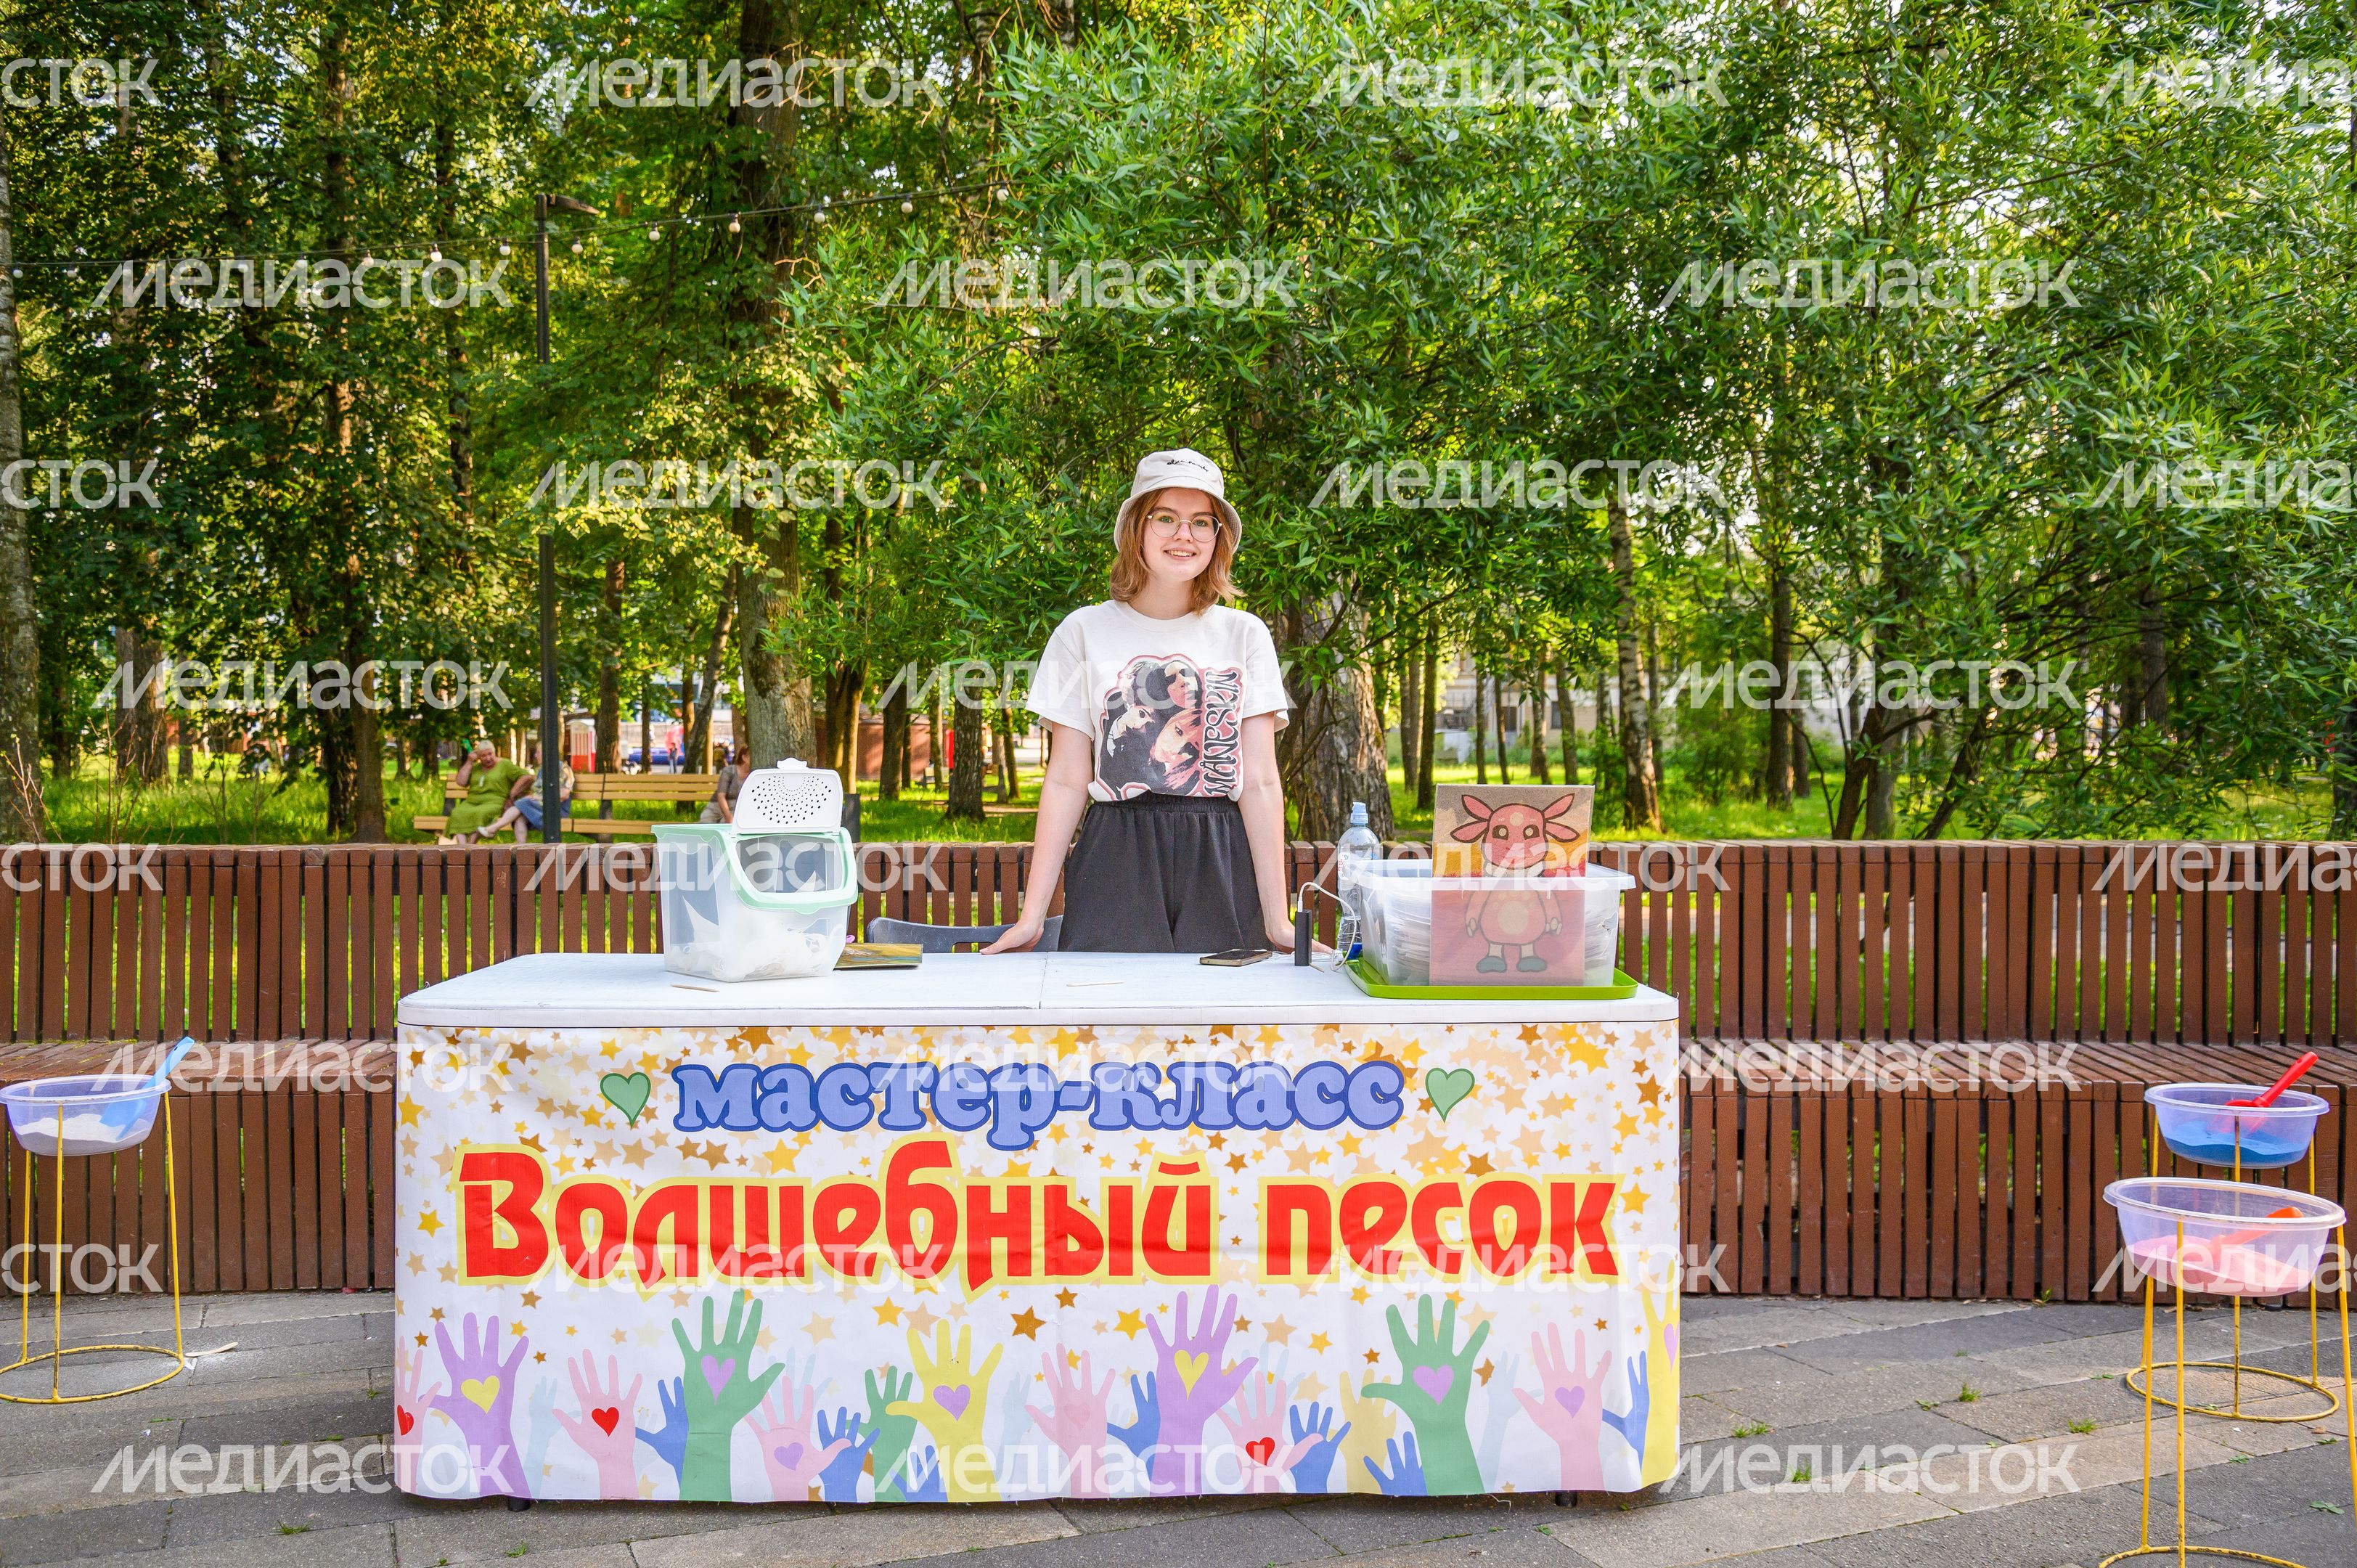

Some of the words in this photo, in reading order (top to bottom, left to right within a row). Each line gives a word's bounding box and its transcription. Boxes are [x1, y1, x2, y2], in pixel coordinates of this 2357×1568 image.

[671, 1060, 1405, 1151] мастер-класс
[458, 1140, 1212, 1292] Волшебный
[1265, 1178, 1620, 1277] песок
